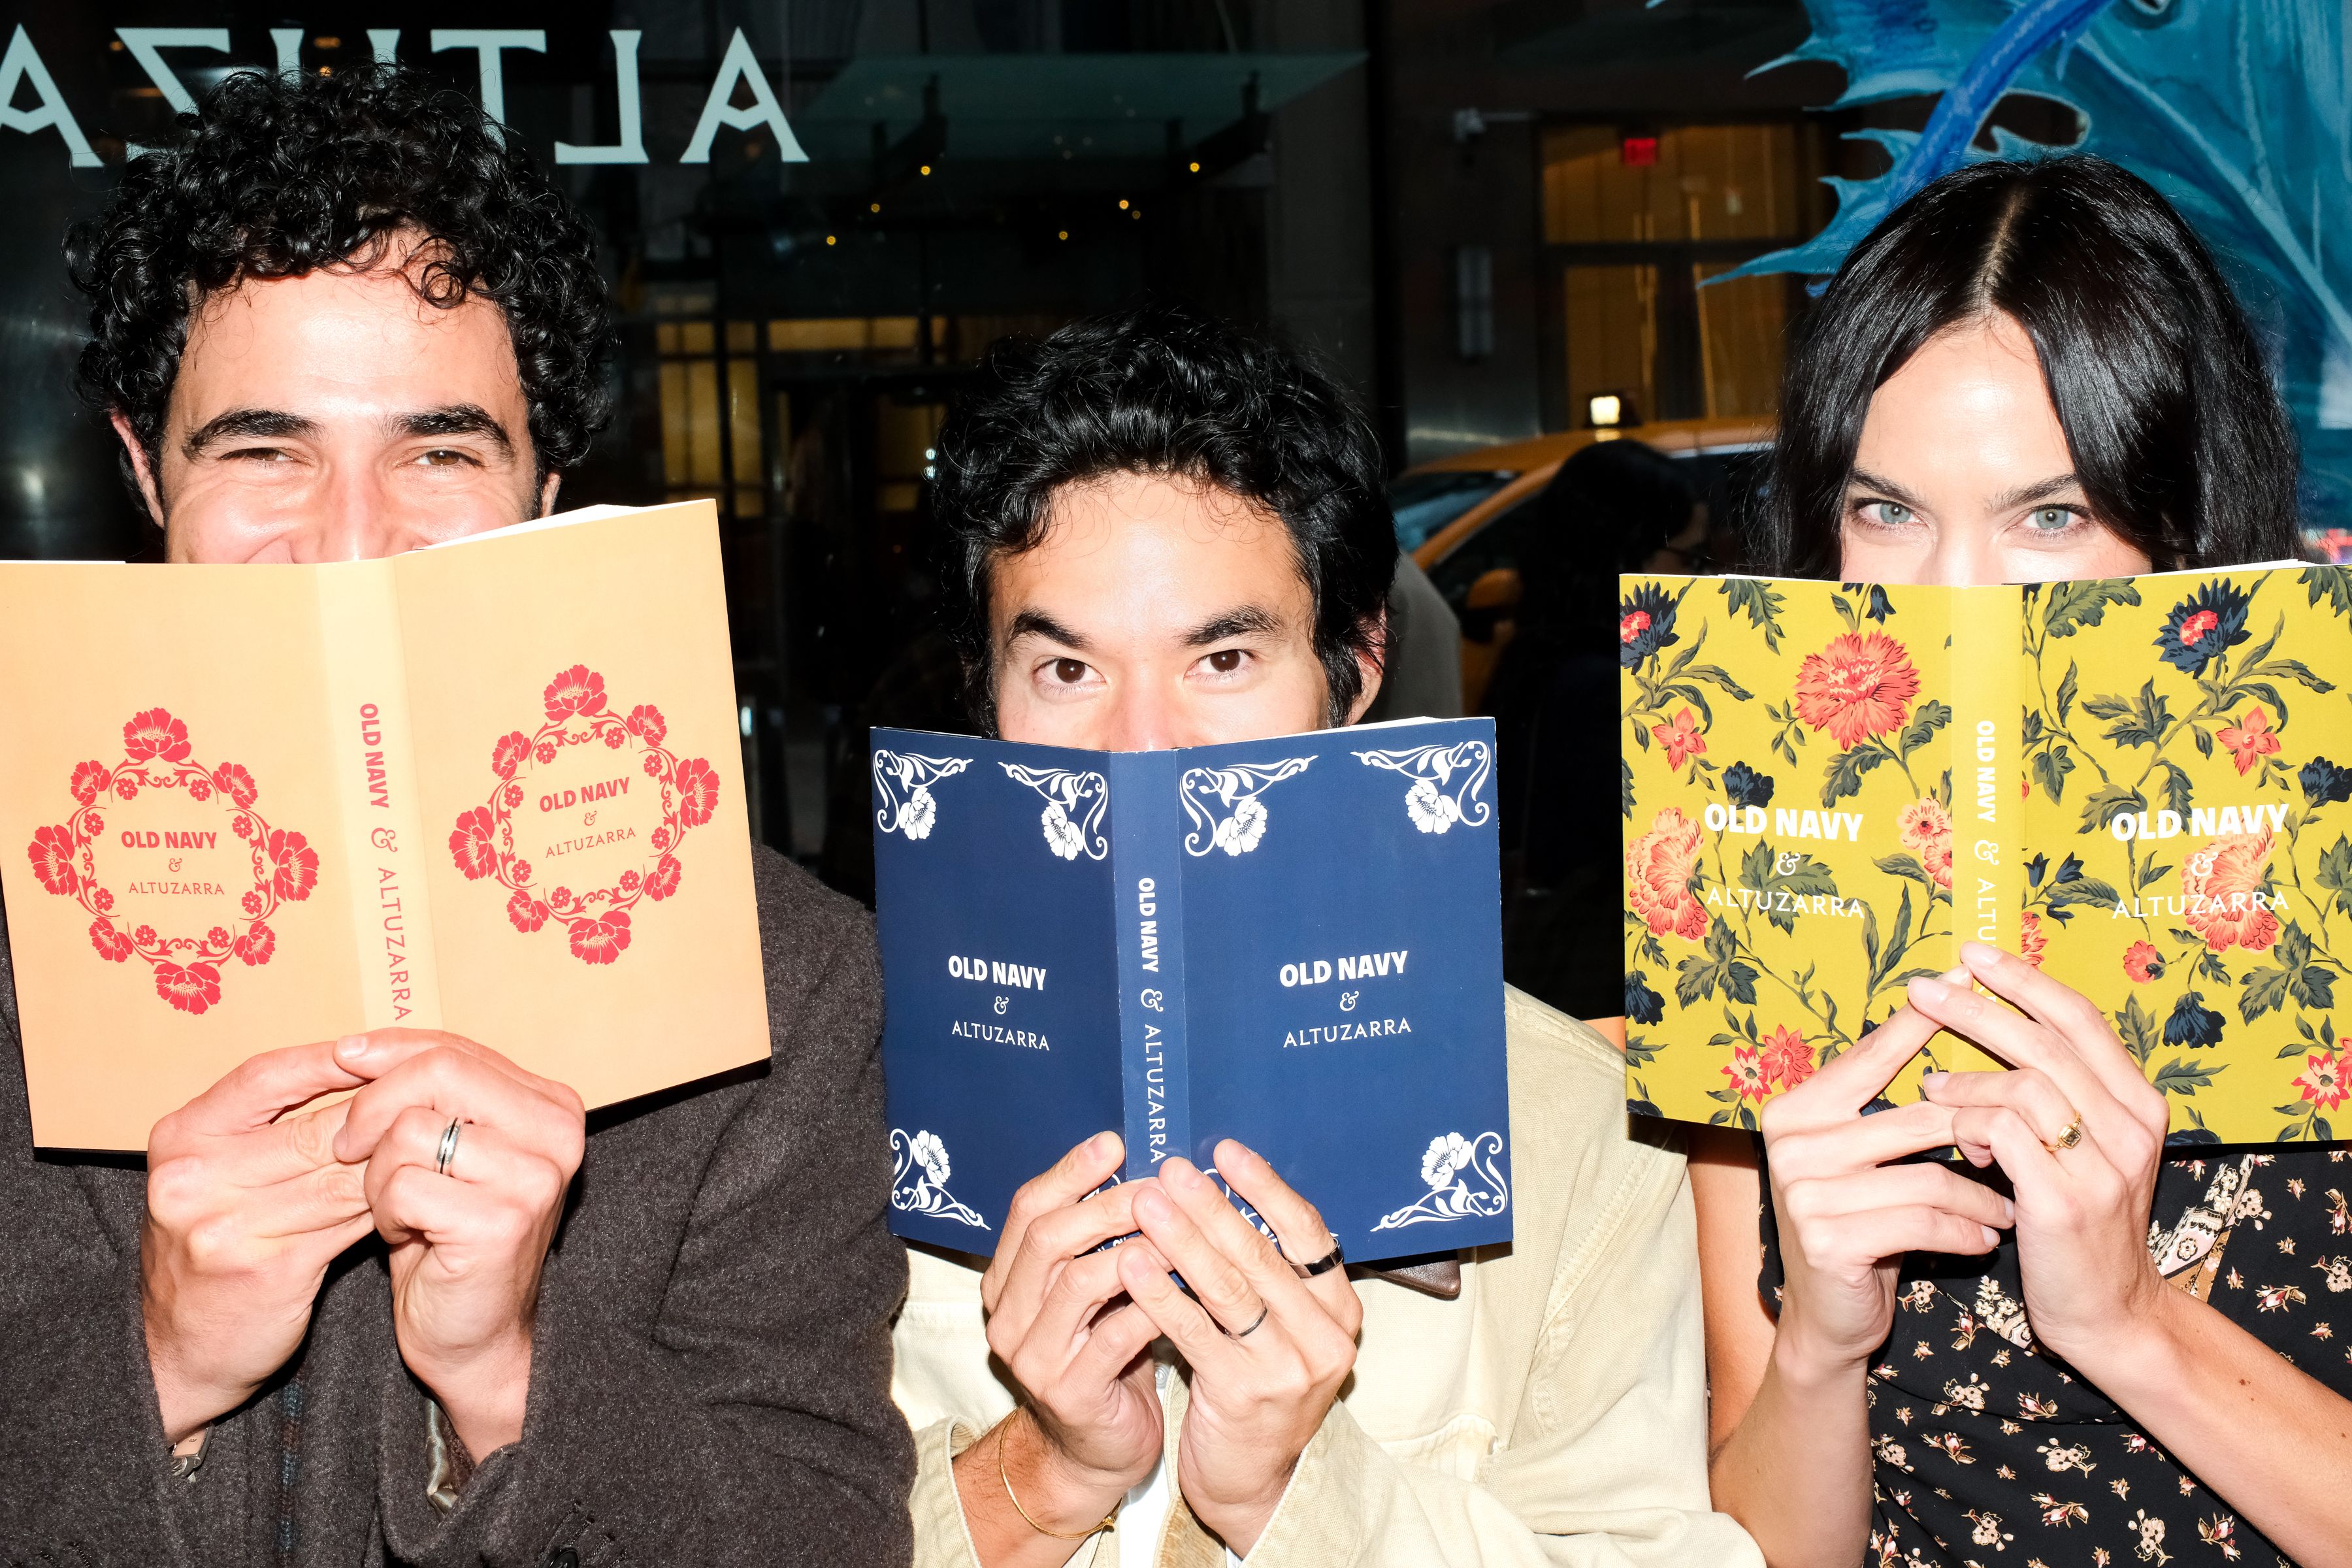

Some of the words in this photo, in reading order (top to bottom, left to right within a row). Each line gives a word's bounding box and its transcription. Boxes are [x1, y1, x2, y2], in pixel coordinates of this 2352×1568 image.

[359, 703, 382, 746] OLD
[1976, 721, 1995, 762] OLD
[365, 751, 389, 809] NAVY
[539, 790, 577, 813] OLD
[581, 776, 630, 804] NAVY
[1977, 767, 1996, 823] NAVY
[584, 810, 598, 826] &
[1704, 803, 1767, 834] OLD
[1775, 808, 1864, 841] NAVY
[2111, 809, 2182, 841] OLD
[2191, 803, 2290, 837] NAVY
[121, 830, 160, 849] OLD
[165, 831, 217, 849] NAVY
[371, 827, 397, 853] &
[545, 826, 636, 858] ALTUZARRA
[1974, 840, 1999, 866] &
[168, 858, 183, 872] &
[1776, 852, 1801, 876] &
[2190, 851, 2219, 877] &
[128, 881, 225, 896] ALTUZARRA
[1138, 877, 1156, 917] OLD
[1706, 886, 1865, 919] ALTUZARRA
[2112, 890, 2289, 919] ALTUZARRA
[378, 867, 412, 1021] ALTUZARRA
[1140, 920, 1160, 973] NAVY
[948, 955, 988, 981] OLD
[992, 961, 1047, 990] NAVY
[1279, 960, 1332, 988] OLD
[1337, 950, 1408, 981] NAVY
[994, 996, 1009, 1015] &
[1141, 988, 1164, 1013] &
[1339, 990, 1360, 1011] &
[951, 1020, 1051, 1051] ALTUZARRA
[1282, 1017, 1412, 1048] ALTUZARRA
[1144, 1024, 1168, 1164] ALTUZARRA
